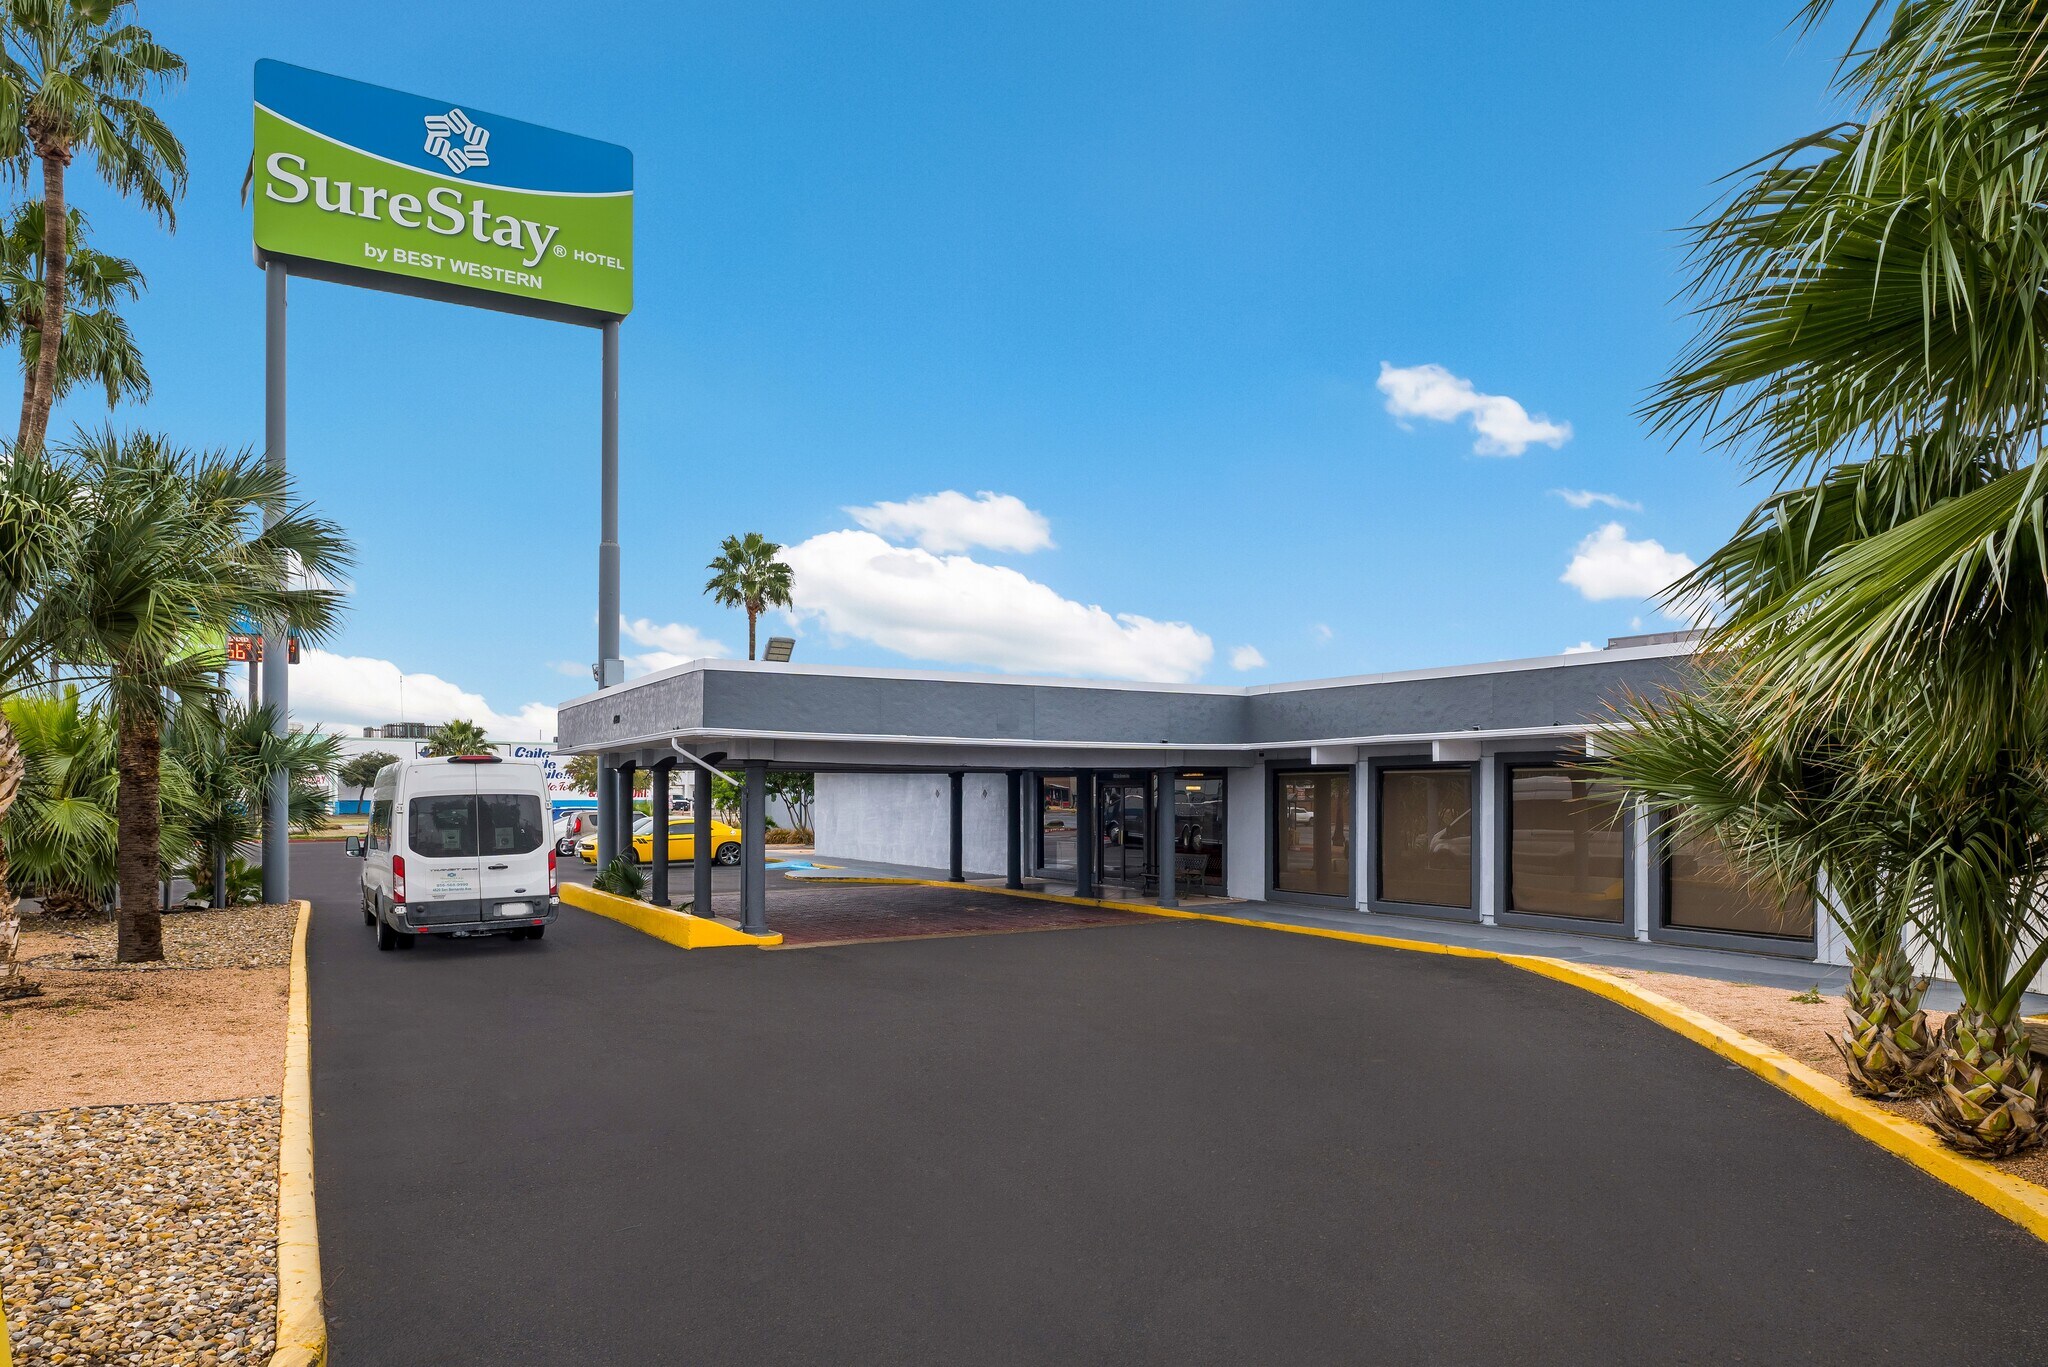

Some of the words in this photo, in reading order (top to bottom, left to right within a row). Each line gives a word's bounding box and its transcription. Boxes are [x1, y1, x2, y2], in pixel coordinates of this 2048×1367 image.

[364, 243, 388, 262] by
[393, 248, 445, 270] BEST
[450, 258, 542, 290] WESTERN
[574, 248, 625, 270] HOTEL
